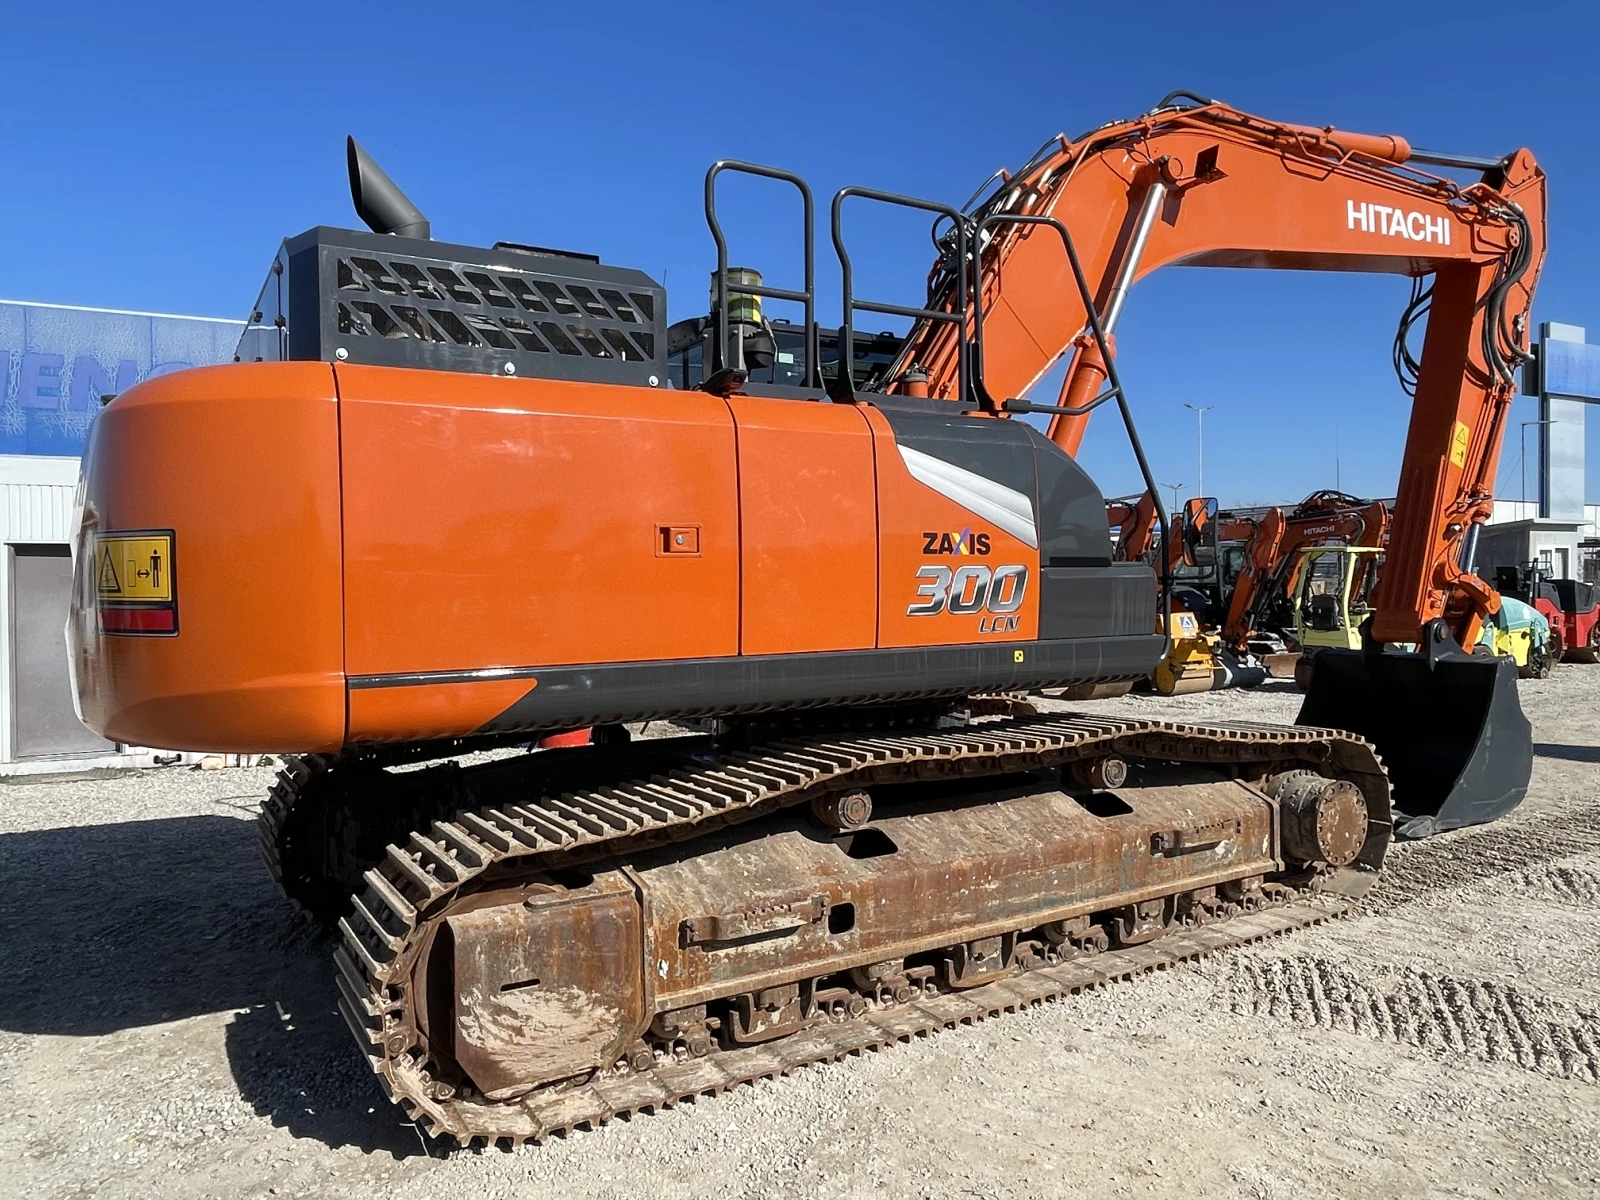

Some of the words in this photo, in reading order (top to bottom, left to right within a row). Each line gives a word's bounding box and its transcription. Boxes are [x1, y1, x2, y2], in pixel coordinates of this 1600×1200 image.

[1347, 199, 1451, 246] HITACHI
[922, 529, 991, 556] ZAXIS
[1303, 525, 1335, 536] HITACHI
[906, 565, 1029, 616] 300
[978, 615, 1020, 634] LCN
